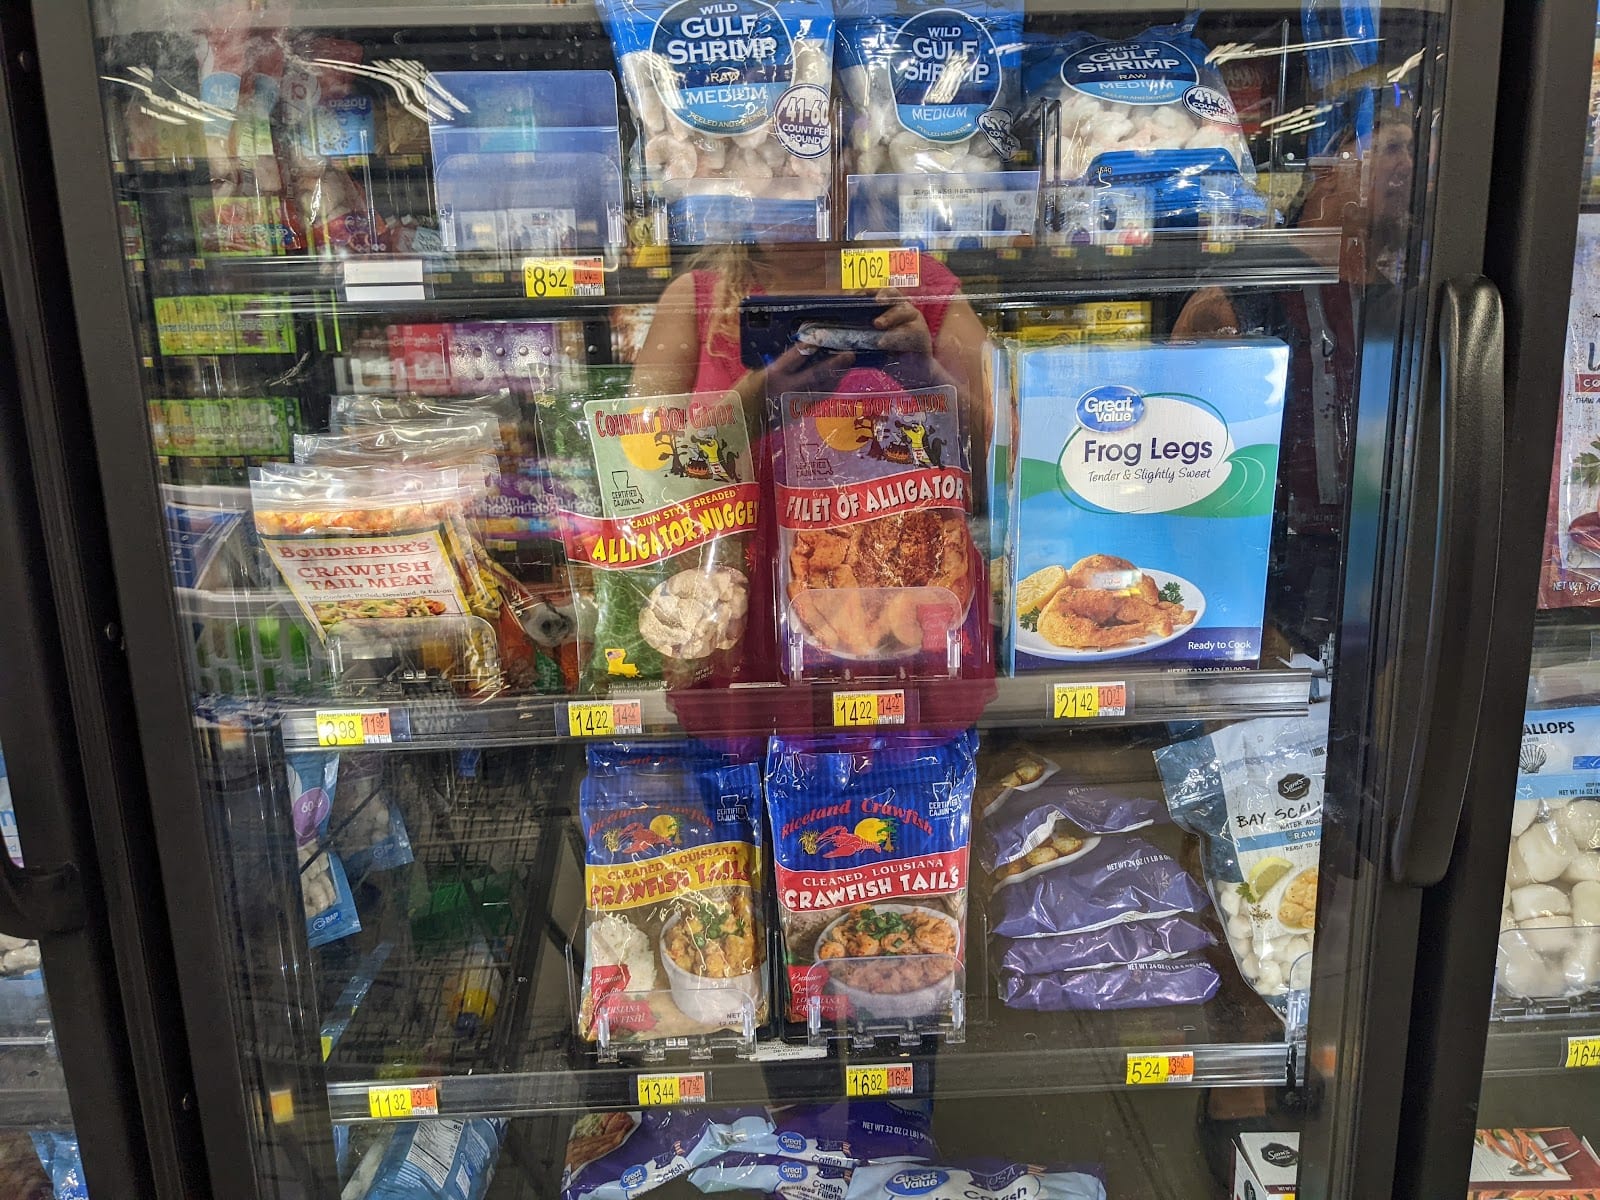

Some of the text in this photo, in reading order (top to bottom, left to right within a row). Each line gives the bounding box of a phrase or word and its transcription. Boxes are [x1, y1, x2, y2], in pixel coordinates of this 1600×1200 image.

[700, 3, 738, 15] WILD
[681, 14, 757, 38] GULF
[928, 27, 961, 37] WILD
[667, 37, 777, 65] SHRIMP
[912, 38, 978, 60] GULF
[1089, 48, 1160, 63] GULF
[1105, 44, 1141, 52] WILD
[1077, 58, 1180, 73] SHRIMP
[710, 71, 740, 83] RAW
[1099, 80, 1174, 91] MEDIUM
[688, 87, 766, 105] MEDIUM
[786, 97, 829, 126] 41-60
[912, 107, 968, 121] MEDIUM
[782, 124, 812, 134] COUNT
[790, 133, 821, 146] POUND
[1084, 397, 1134, 414] Great
[1095, 411, 1133, 423] Value
[1084, 437, 1213, 466] Frog Legs
[1088, 467, 1211, 484] Tender & Slightly Sweet
[786, 475, 964, 522] FILET OF ALLIGATOR
[631, 490, 737, 529] CAJUN STYLE BREADED
[592, 518, 700, 563] ALLIGATOR
[277, 541, 431, 558] BOUDREAUX'S
[297, 561, 433, 578] CRAWFISH
[306, 574, 434, 591] TAIL MEAT
[1188, 640, 1251, 651] Ready to Cook
[781, 798, 934, 840] Riceland Crawfish
[929, 809, 950, 817] CAJUN
[1236, 812, 1266, 828] BAY
[1294, 830, 1316, 839] RAW
[672, 846, 739, 865] LOUISIANA
[803, 858, 944, 887] CLEANED, LOUISIANA
[1106, 862, 1118, 872] NET
[1118, 861, 1128, 870] WT
[590, 859, 750, 906] CRAWFISH TAILS
[784, 866, 960, 909] CRAWFISH TAILS
[862, 1121, 874, 1131] NET
[874, 1123, 884, 1132] WT
[885, 1125, 894, 1133] 32
[894, 1126, 902, 1135] OZ
[781, 1135, 802, 1146] Great
[781, 1165, 802, 1174] Great
[893, 1171, 938, 1185] Great
[903, 1178, 938, 1190] Value
[812, 1180, 843, 1194] Catfish
